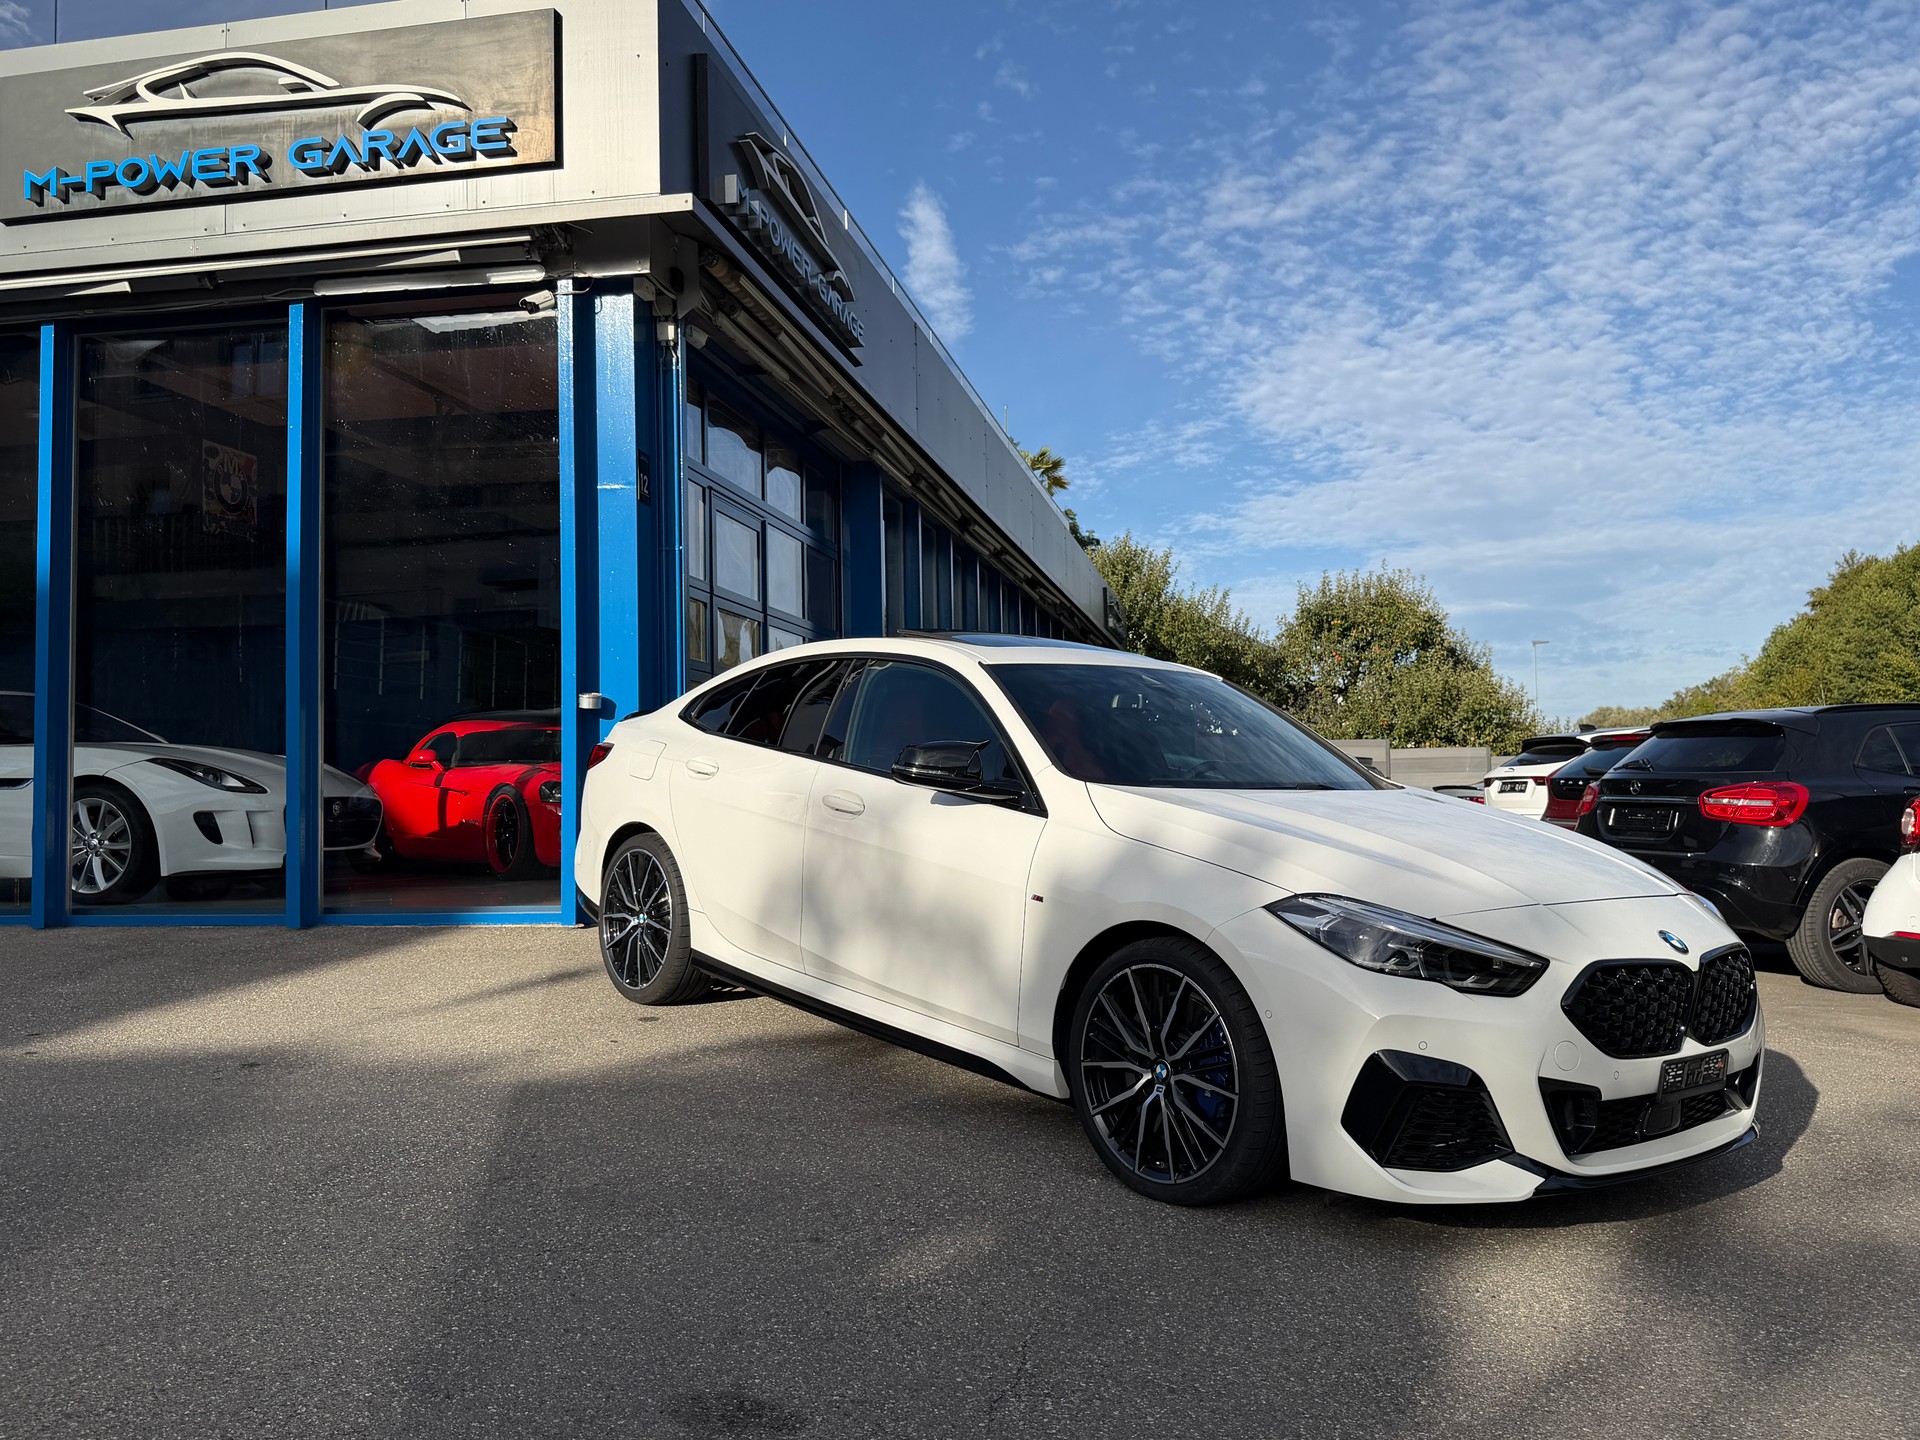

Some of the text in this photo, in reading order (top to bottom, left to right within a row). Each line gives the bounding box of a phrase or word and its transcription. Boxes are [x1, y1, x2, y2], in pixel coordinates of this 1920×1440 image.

[24, 117, 507, 200] M-POWER GARAGE
[737, 177, 865, 348] M-POWER GARAGE
[640, 472, 649, 494] 12
